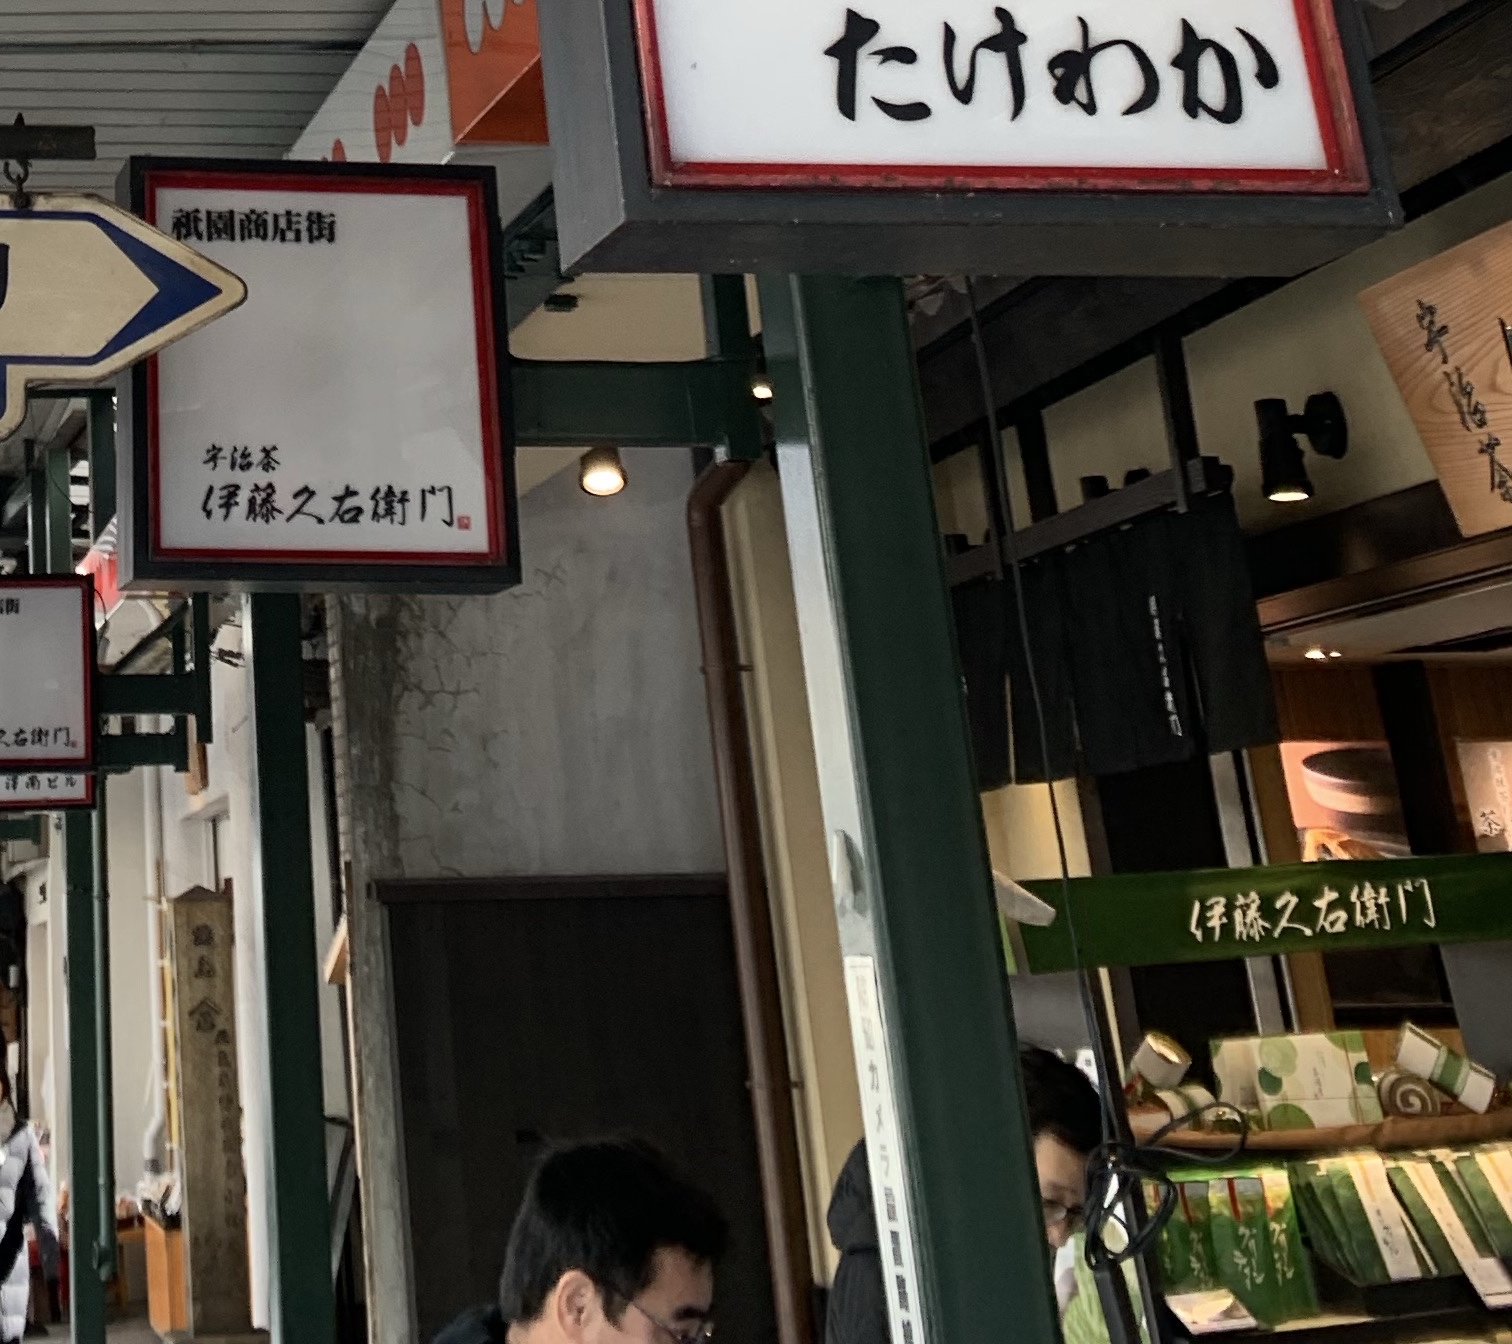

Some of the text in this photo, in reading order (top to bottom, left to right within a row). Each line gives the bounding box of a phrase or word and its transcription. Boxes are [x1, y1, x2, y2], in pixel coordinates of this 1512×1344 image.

[823, 6, 1280, 125] たけわか
[170, 207, 338, 245] 祇園商店街
[202, 443, 281, 474] 宇治茶
[200, 481, 456, 528] 伊藤久右衛門
[1190, 878, 1436, 942] 伊藤久右衛門
